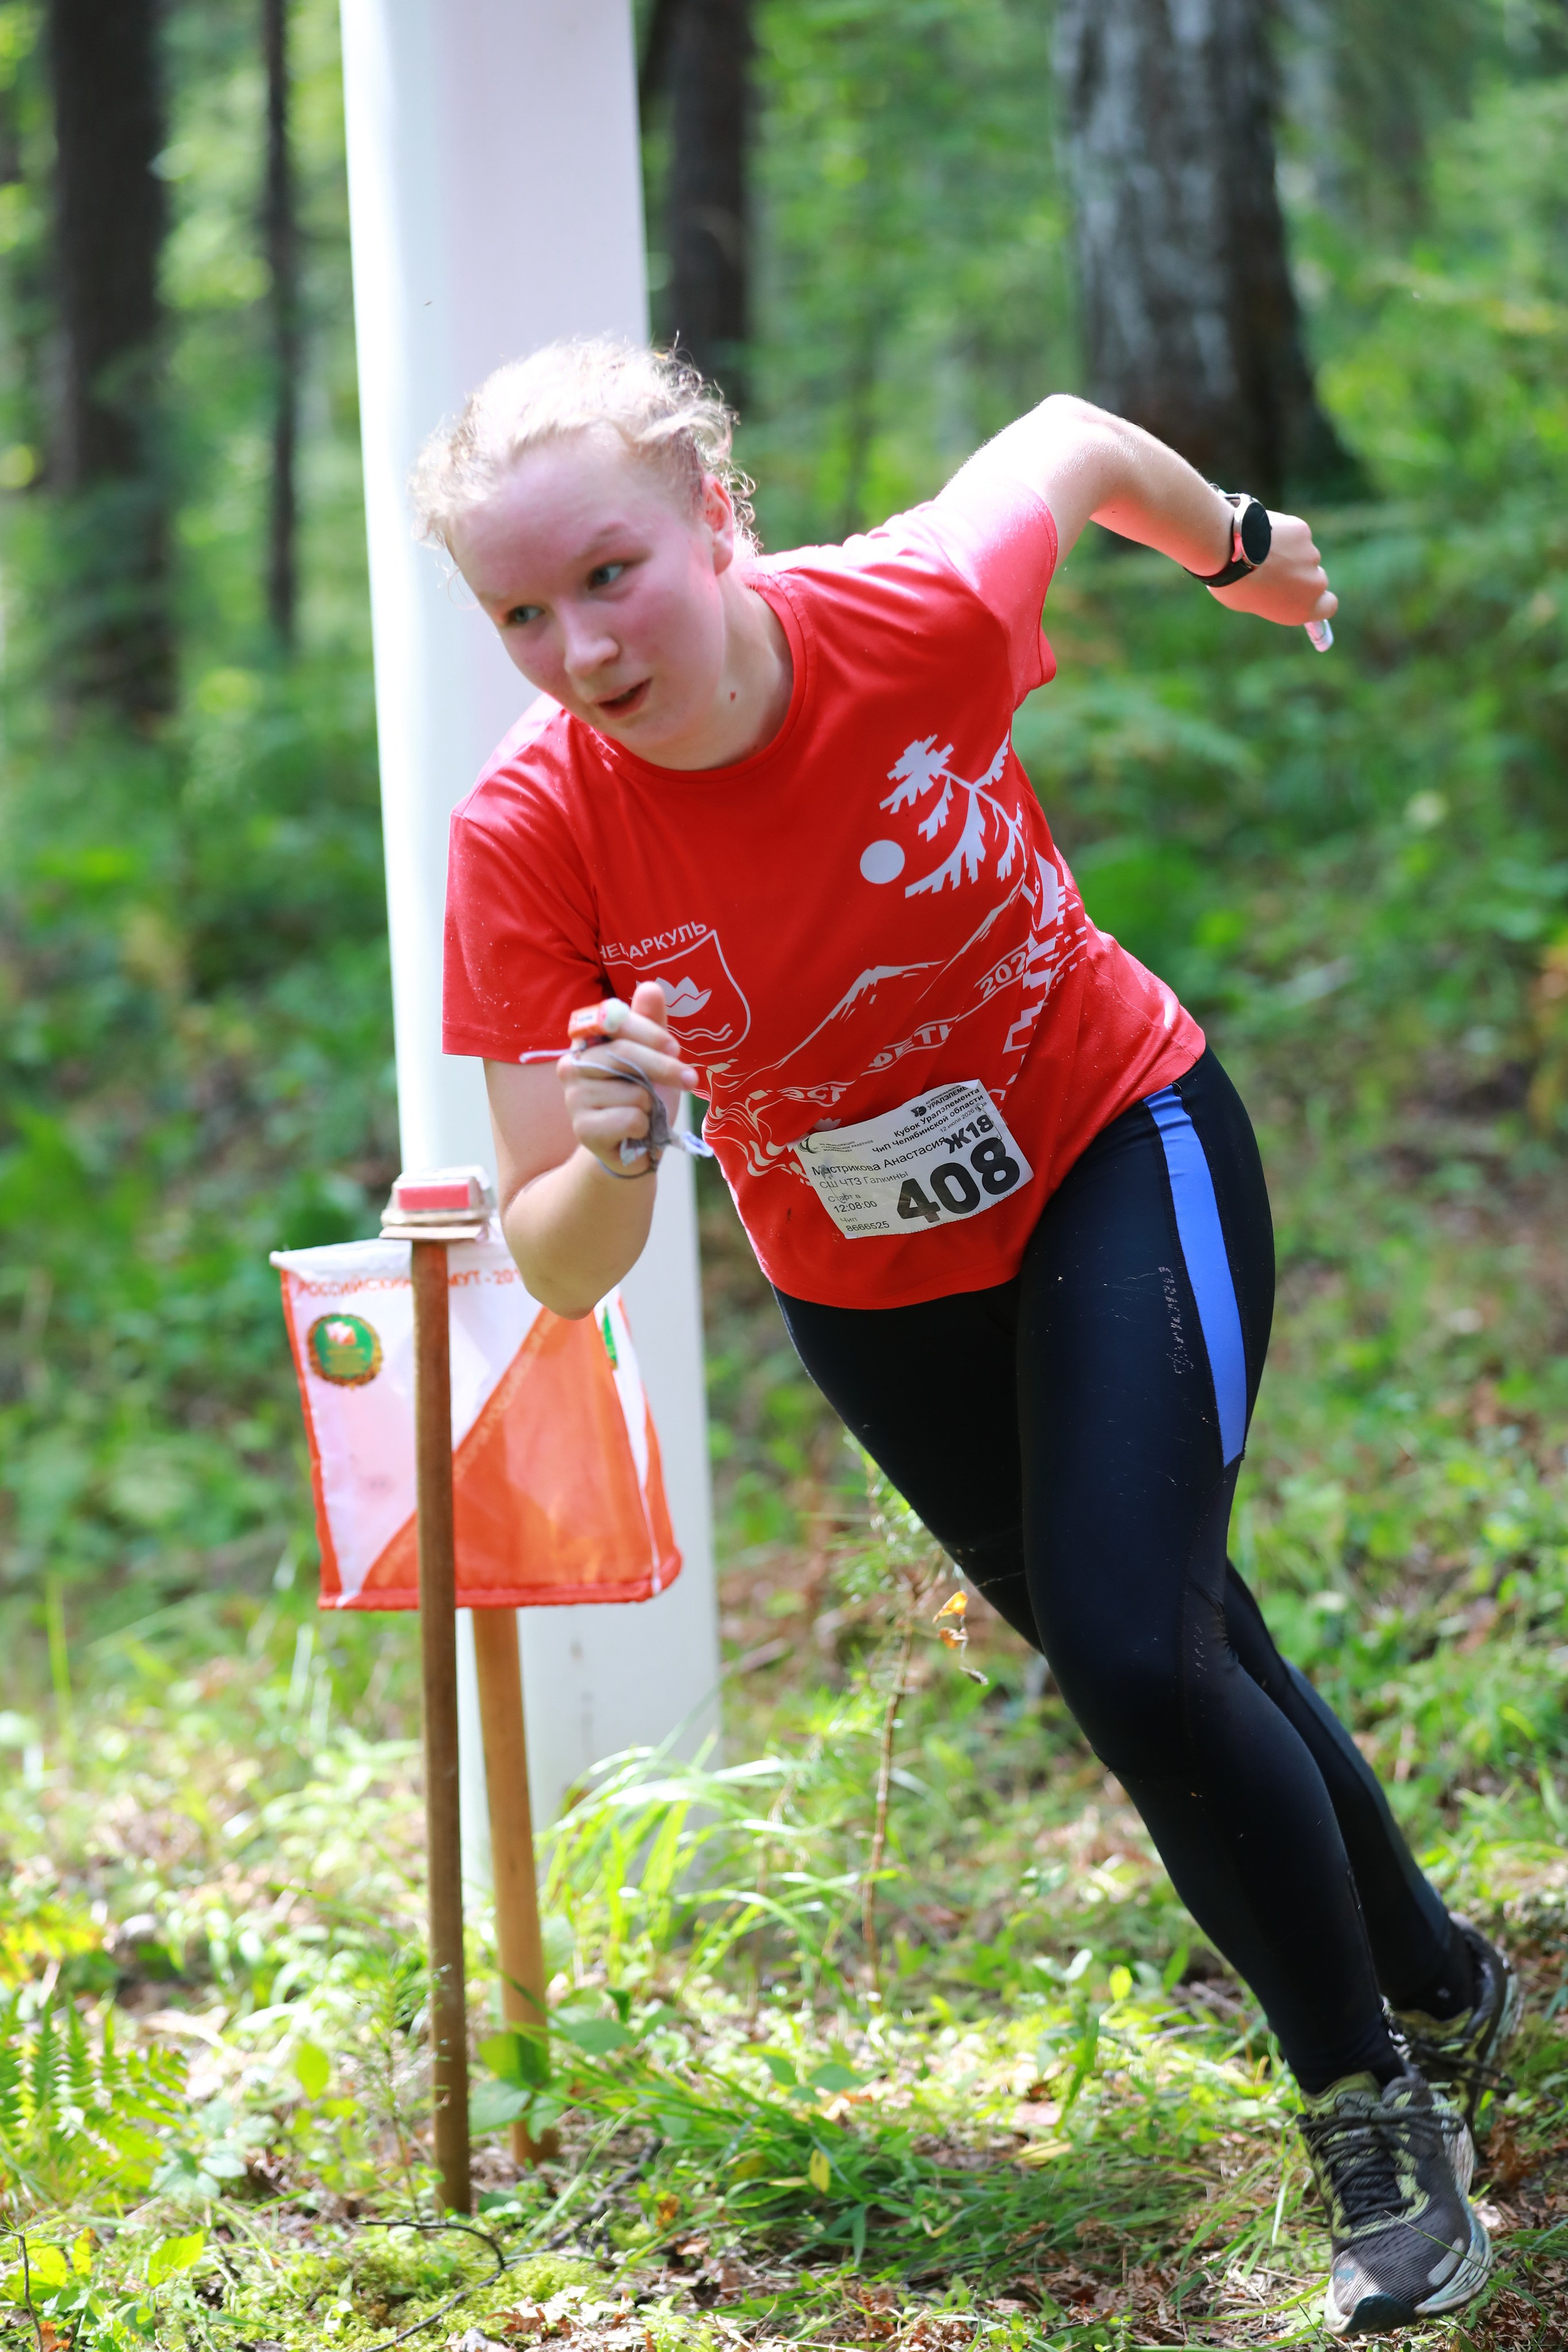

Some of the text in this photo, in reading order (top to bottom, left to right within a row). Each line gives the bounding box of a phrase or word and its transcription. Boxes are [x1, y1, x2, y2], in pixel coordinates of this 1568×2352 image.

[980, 951, 1027, 999] 202
[894, 1088, 980, 1137] Кубок Уралэлемента
[927, 1086, 968, 1110] УРАЛЭЛЕМЕ
[872, 1095, 984, 1153] ЧиП Челябинской области
[943, 1115, 994, 1154] Ж18
[948, 1118, 962, 1129] июля
[884, 1137, 944, 1168] Анастасия
[820, 1180, 838, 1189] СШ
[863, 1171, 909, 1184] Галкины
[897, 1137, 1020, 1223] 408
[834, 1200, 877, 1213] 12:08:00
[846, 1221, 890, 1231] 8666525
